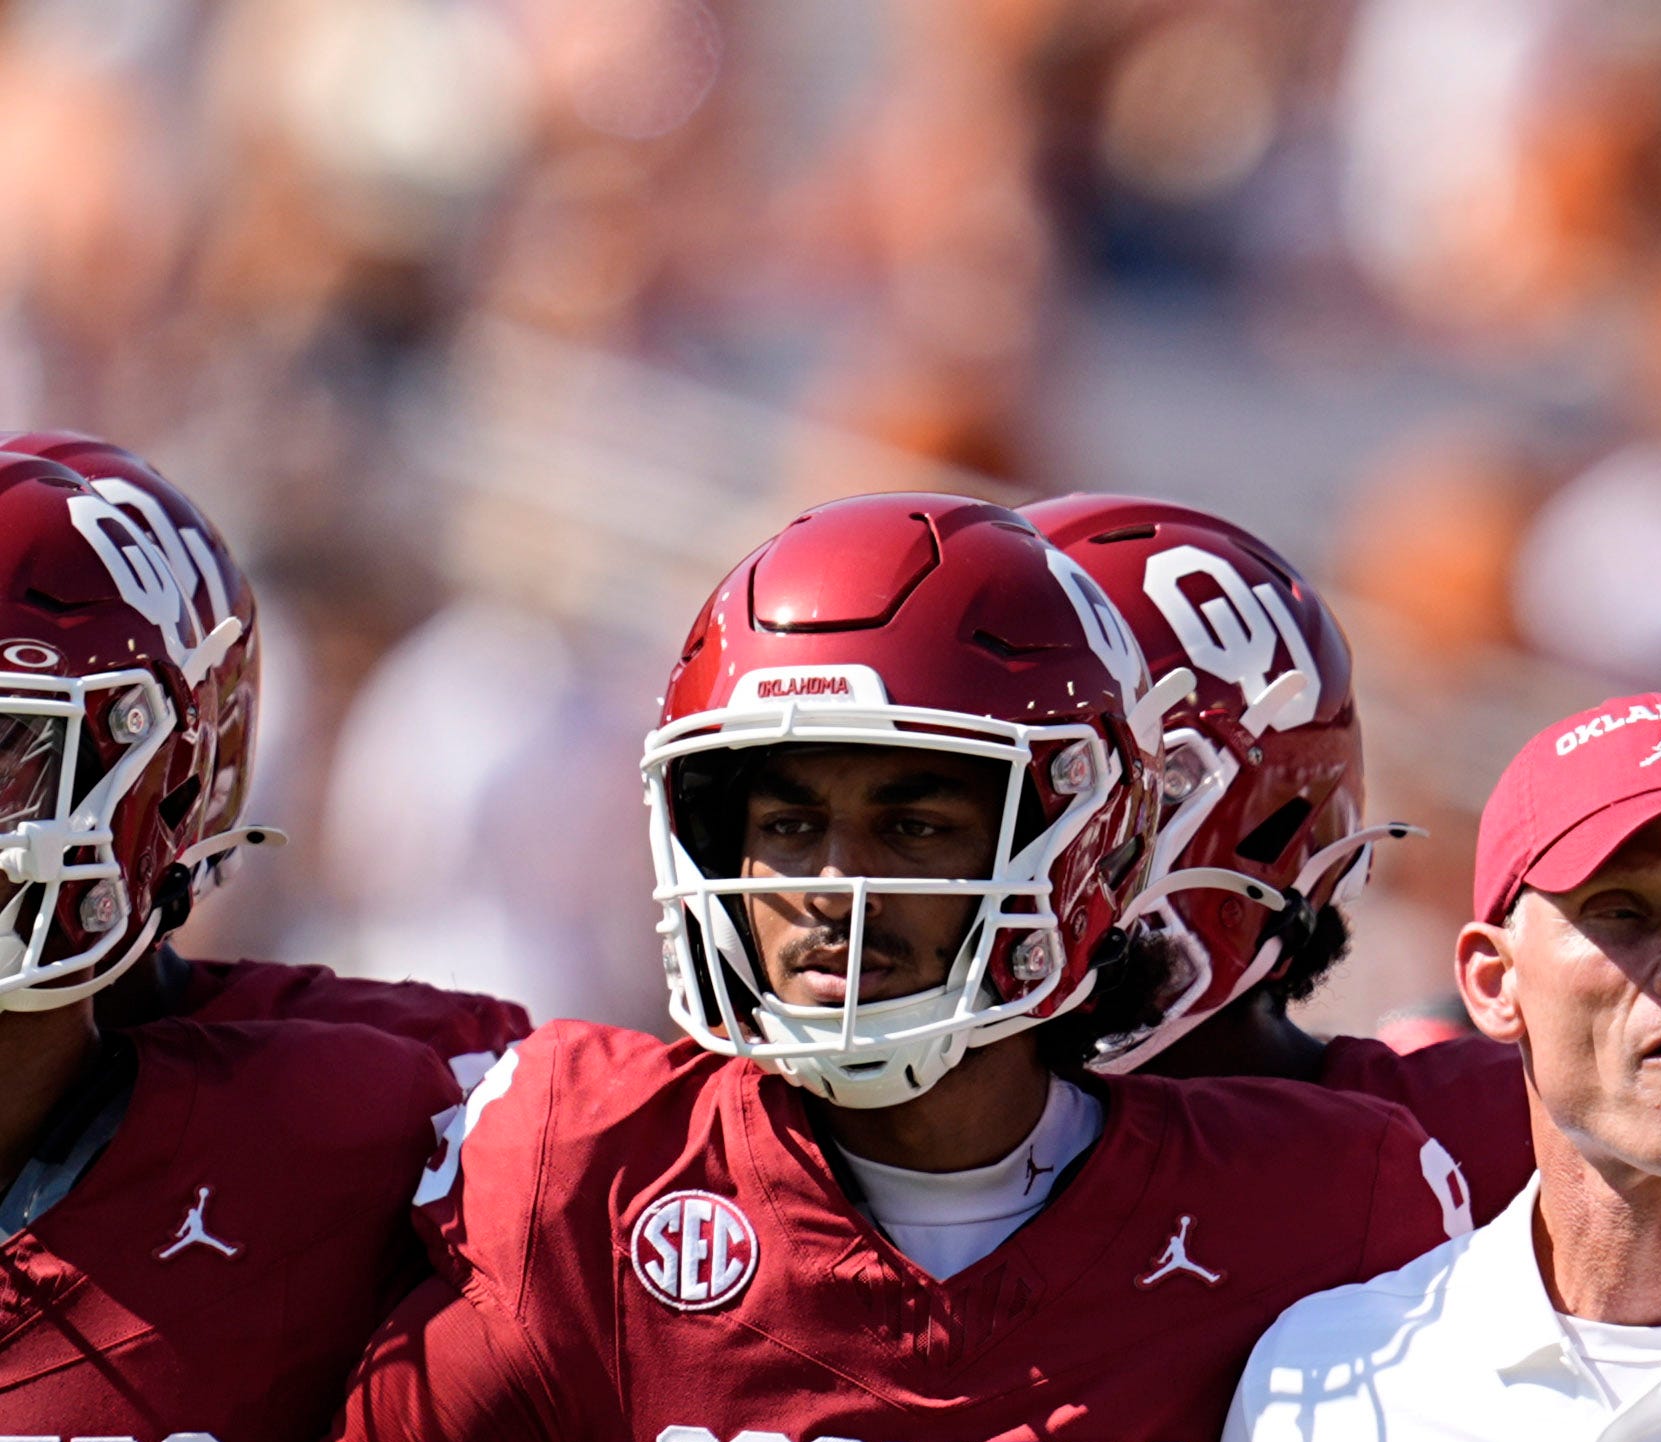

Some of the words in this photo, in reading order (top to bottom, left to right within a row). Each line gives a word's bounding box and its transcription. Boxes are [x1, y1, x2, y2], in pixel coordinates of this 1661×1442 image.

[757, 676, 850, 700] OKLAHOMA
[1143, 544, 1321, 733] OU
[641, 1200, 745, 1302] SEC
